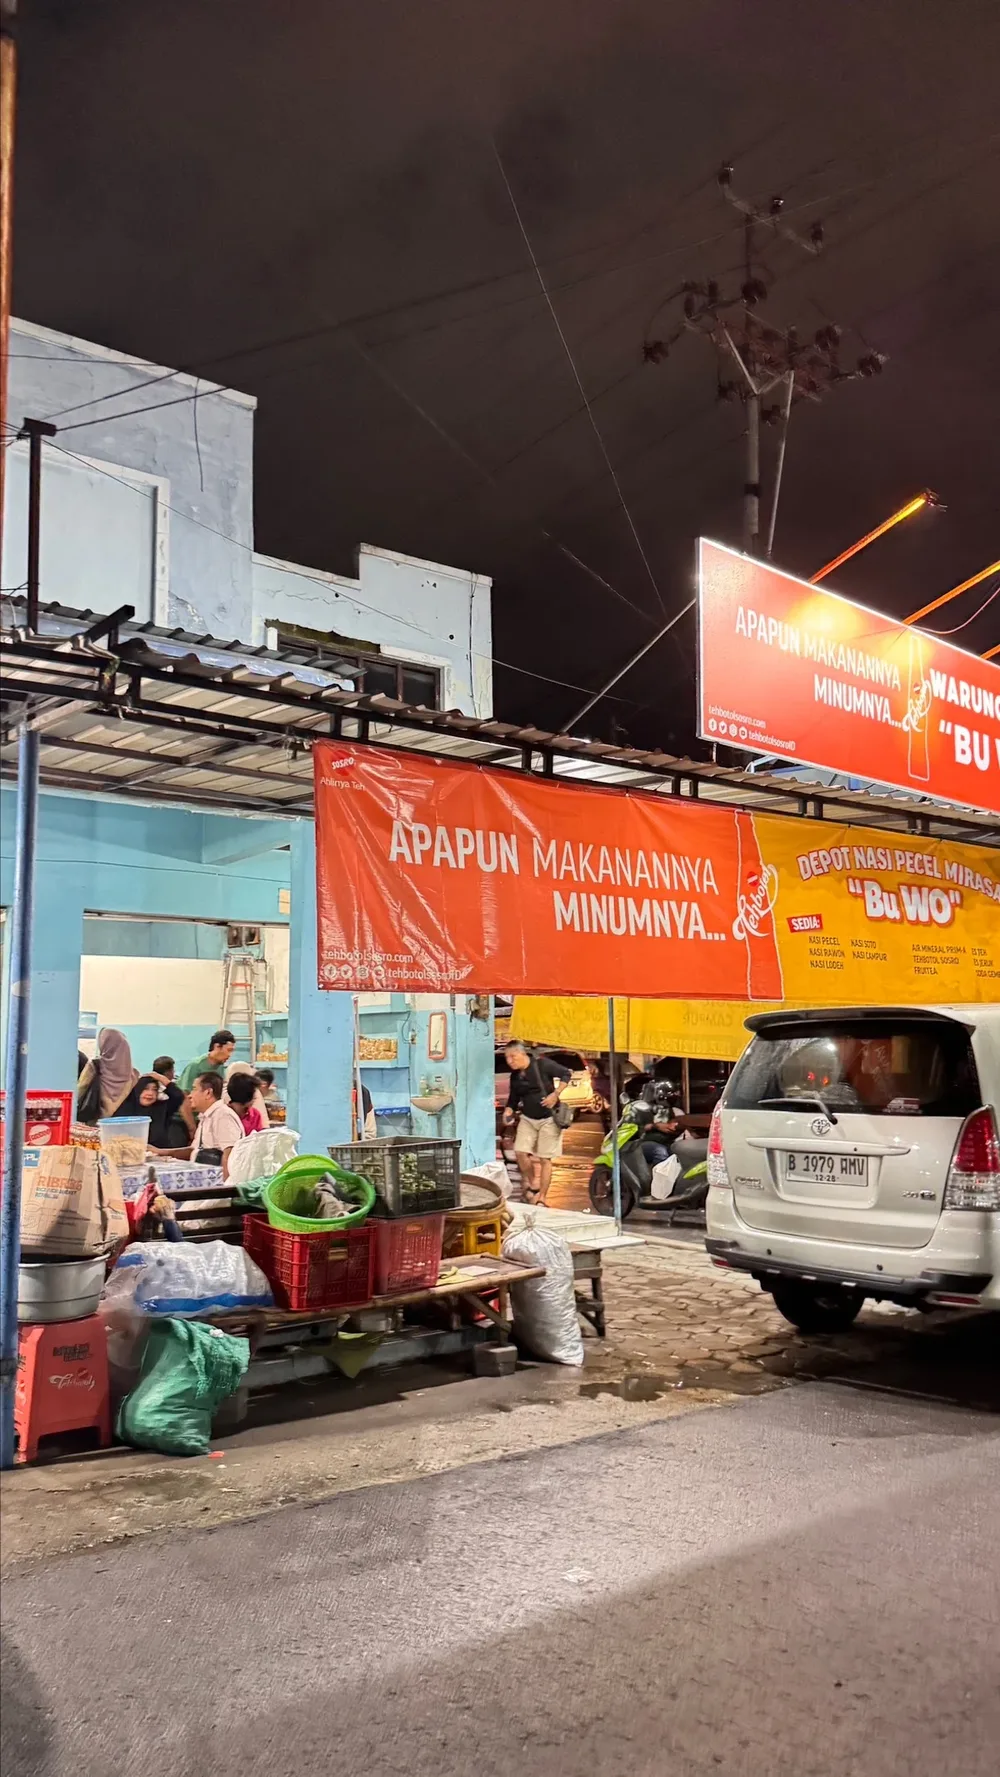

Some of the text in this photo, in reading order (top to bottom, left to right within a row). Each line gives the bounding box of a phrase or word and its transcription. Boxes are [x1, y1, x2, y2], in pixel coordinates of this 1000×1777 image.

[735, 606, 901, 691] APAPUN MAKANANNYA
[708, 704, 766, 729] tehbotolsosro.com
[748, 730, 796, 751] tehbotolsosroID
[331, 757, 355, 770] SOSRO
[320, 776, 366, 790] Ahlinya Teh
[389, 820, 719, 895] APAPUN MAKANANNYA
[797, 846, 850, 881] DEPOT
[852, 846, 892, 870] NASI
[895, 850, 942, 878] PECEL
[554, 891, 726, 941] MINUMNYA...
[791, 916, 820, 931] SEDIA:
[808, 936, 840, 946] NASI PECEL
[850, 939, 864, 948] NASI
[809, 948, 846, 958] NASI RAWON
[852, 951, 865, 960] NASI
[810, 960, 824, 969] NASI
[788, 1154, 865, 1176] B 1979 AMV
